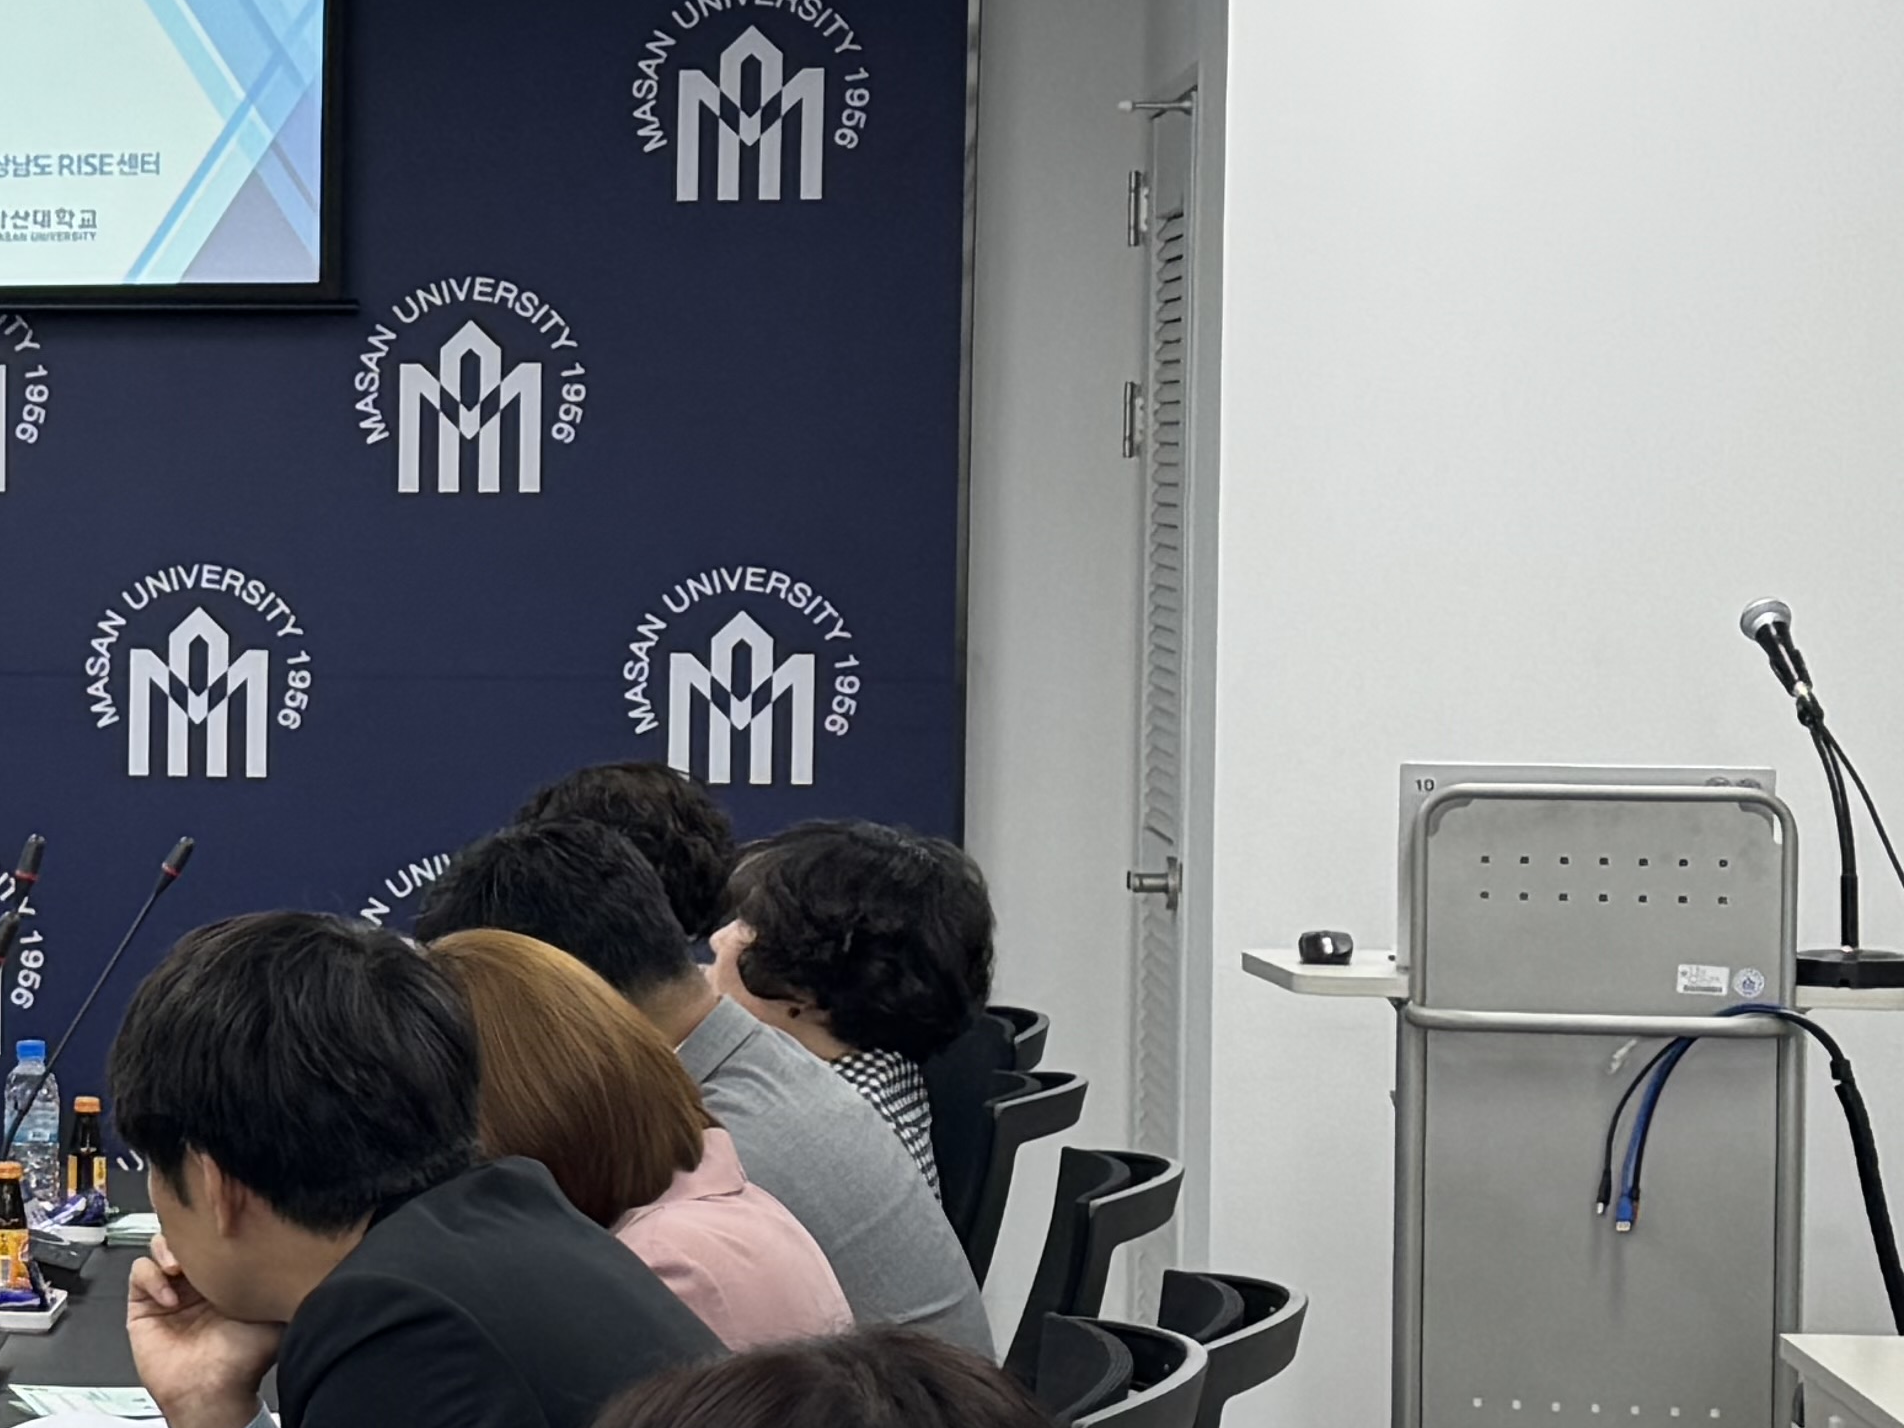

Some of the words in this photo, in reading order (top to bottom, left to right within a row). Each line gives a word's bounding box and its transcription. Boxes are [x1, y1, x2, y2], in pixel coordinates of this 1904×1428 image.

[633, 30, 675, 152] MASAN
[834, 68, 869, 148] 1956
[15, 365, 48, 443] 1956
[355, 324, 396, 444] MASAN
[393, 277, 577, 349] UNIVERSITY
[552, 363, 586, 443] 1956
[85, 610, 126, 728] MASAN
[122, 564, 303, 636] UNIVERSITY
[277, 651, 311, 729] 1956
[623, 614, 666, 734] MASAN
[663, 567, 851, 640] UNIVERSITY
[825, 655, 860, 735] 1956
[9, 930, 44, 1009] 1956
